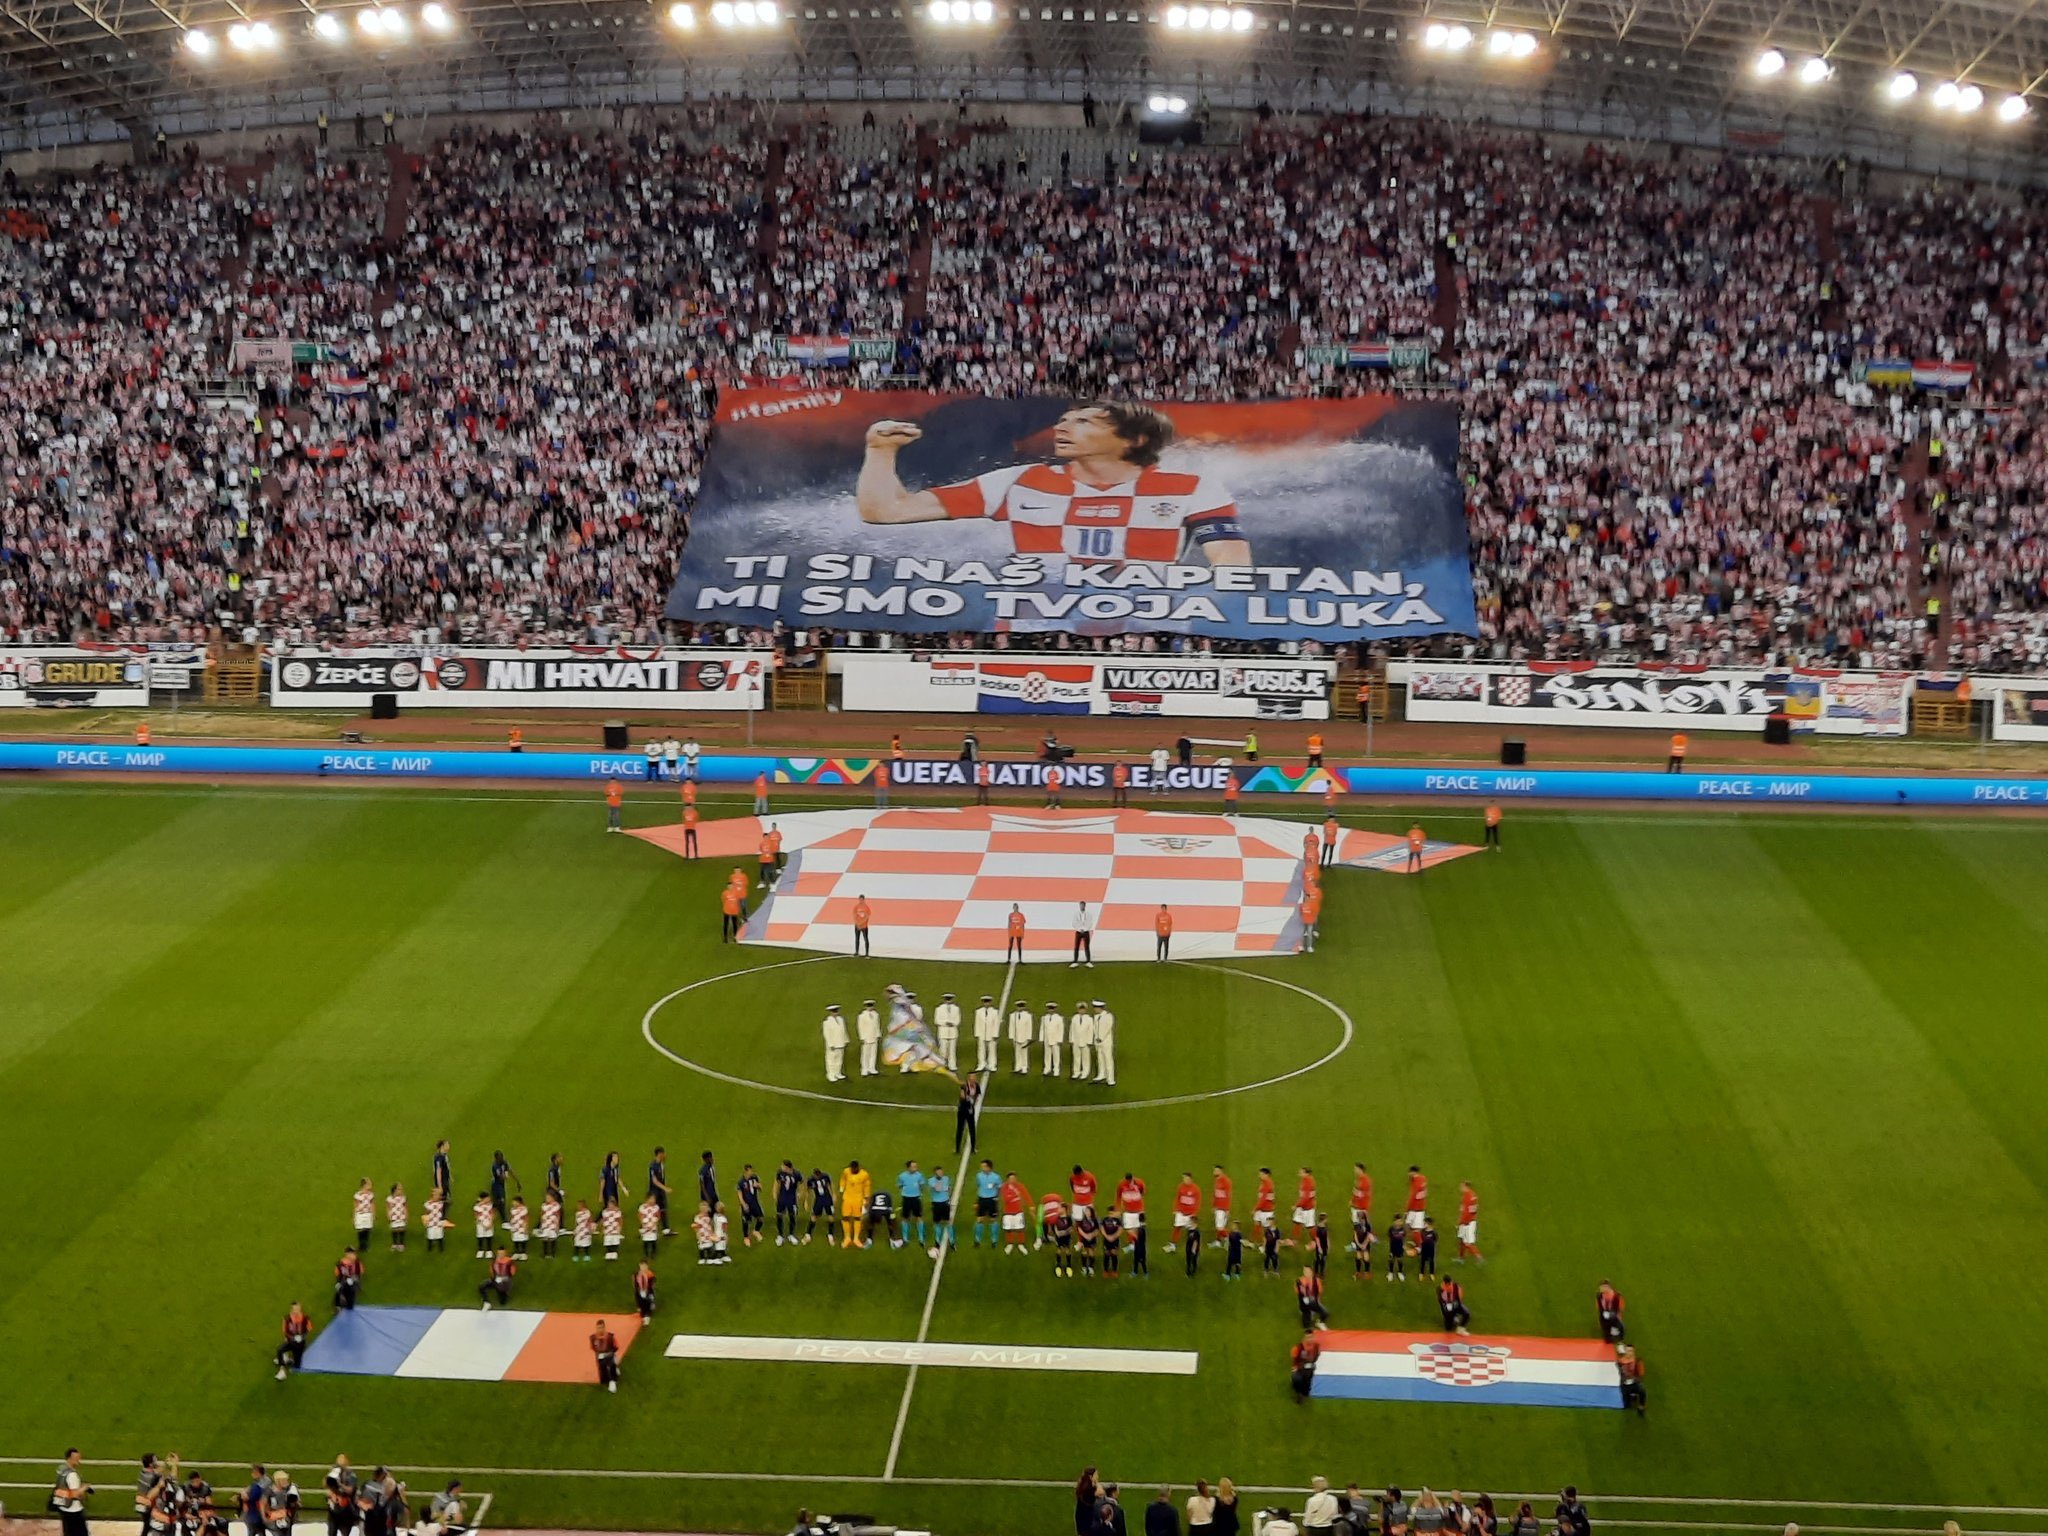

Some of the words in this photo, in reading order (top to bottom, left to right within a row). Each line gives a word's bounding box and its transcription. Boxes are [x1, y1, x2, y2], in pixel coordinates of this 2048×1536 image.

[1077, 528, 1113, 557] 10
[724, 555, 789, 580] TI
[806, 553, 874, 581] SI
[894, 552, 1044, 587] NAŠ
[1063, 562, 1426, 599] KAPETAN,
[695, 583, 782, 611] MI
[799, 585, 965, 617] SMO
[985, 590, 1227, 623] TVOJA
[1246, 596, 1445, 628] LUKA
[46, 662, 124, 684] GRUDE
[314, 662, 387, 685] ŽEPČE
[485, 660, 537, 690] MI
[544, 661, 679, 690] HRVATI
[1107, 669, 1217, 690] VUKOVAR
[56, 750, 110, 766] PEACE
[323, 756, 377, 770] PEACE
[590, 760, 643, 775] PEACE
[892, 761, 967, 784] UEFA
[973, 763, 1105, 787] NATIONS
[1425, 775, 1479, 790] PEACE
[1699, 780, 1752, 796] PEACE
[1974, 785, 2029, 801] PEACE
[795, 1343, 925, 1361] PEACE
